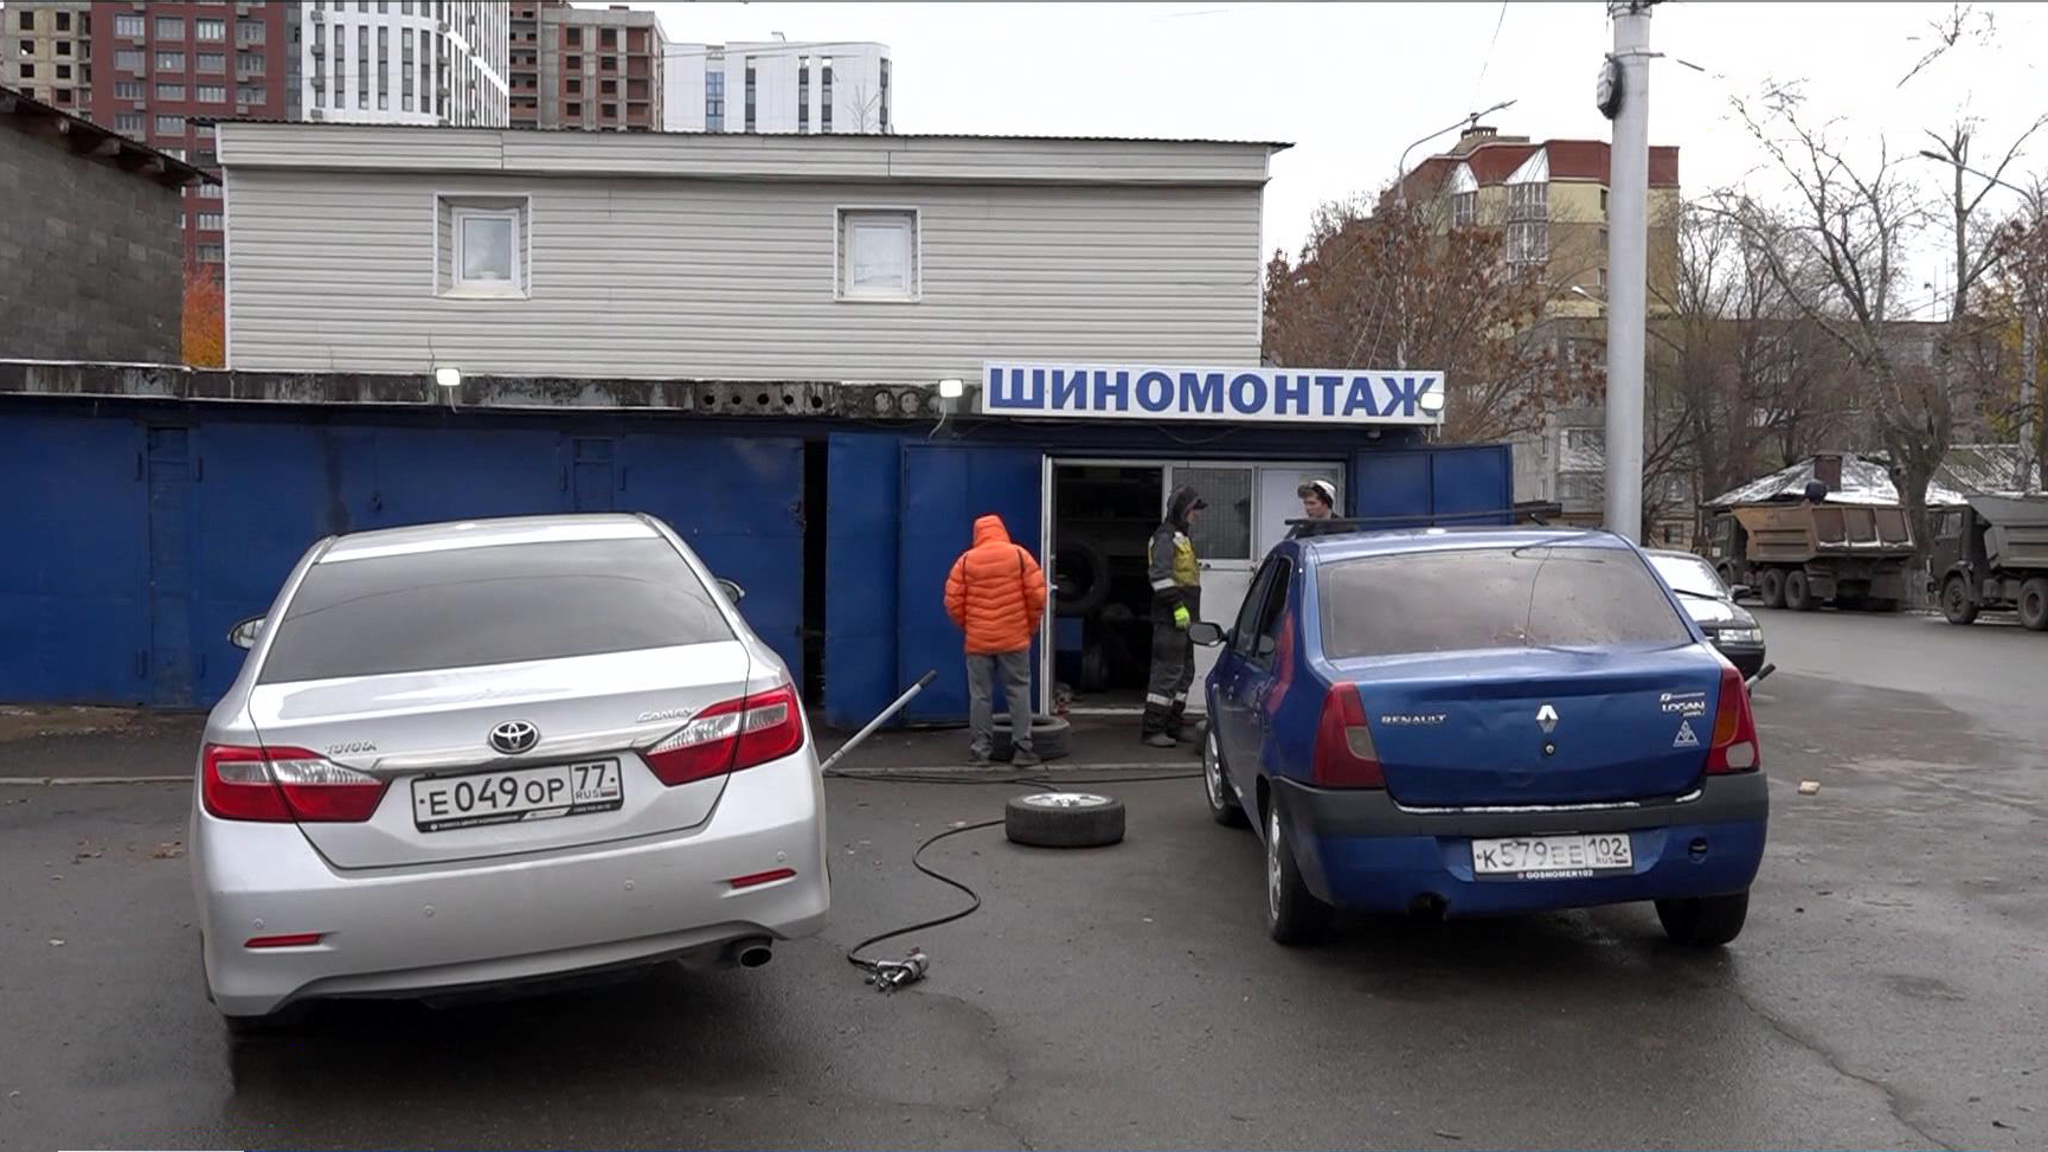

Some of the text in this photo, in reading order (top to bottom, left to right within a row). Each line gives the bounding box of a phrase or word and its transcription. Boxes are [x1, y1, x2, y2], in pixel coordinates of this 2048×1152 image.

[989, 367, 1437, 417] ШИНОМОНТАЖ
[1661, 701, 1705, 712] LOGAN
[1381, 714, 1447, 725] RENAULT
[325, 741, 378, 755] TOYOTA
[574, 764, 606, 790] 77
[575, 789, 600, 800] RUS
[1588, 838, 1624, 857] 102
